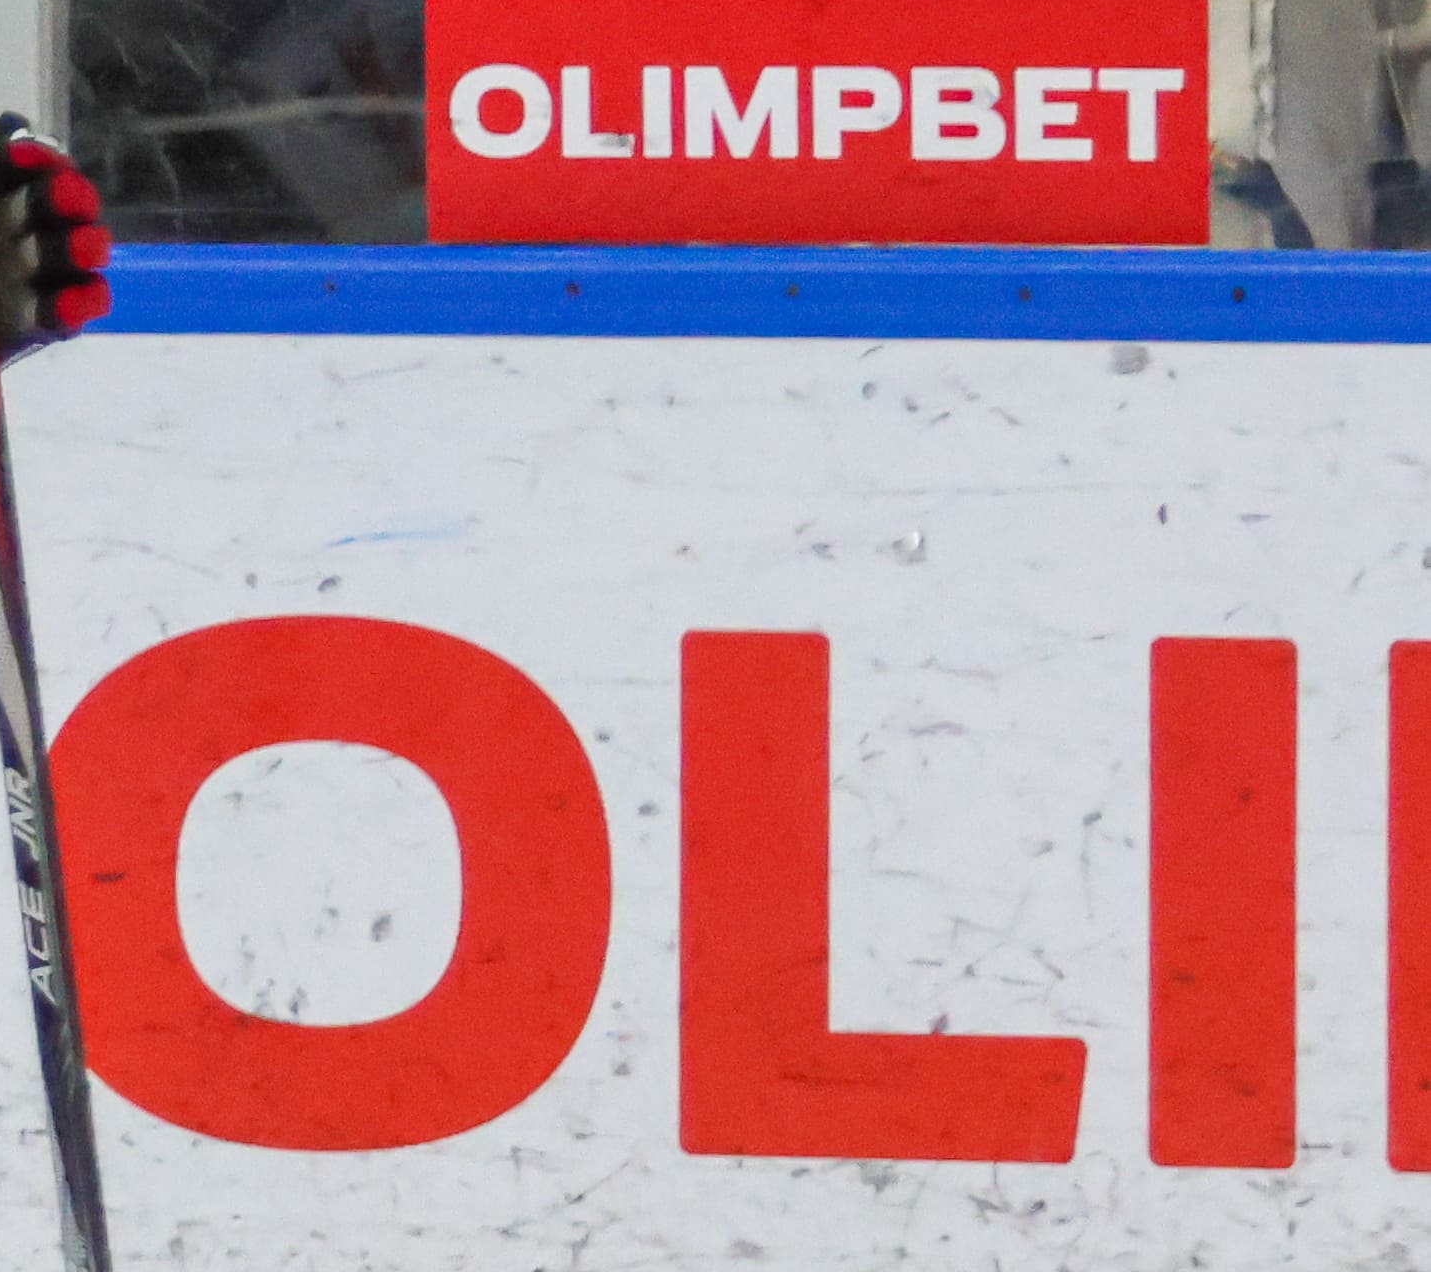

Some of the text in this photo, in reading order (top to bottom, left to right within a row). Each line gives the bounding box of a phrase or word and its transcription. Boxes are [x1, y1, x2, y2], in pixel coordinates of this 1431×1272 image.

[447, 62, 1185, 162] OLIMPBET
[15, 888, 57, 1006] ACE
[45, 614, 1431, 1172] OLI
